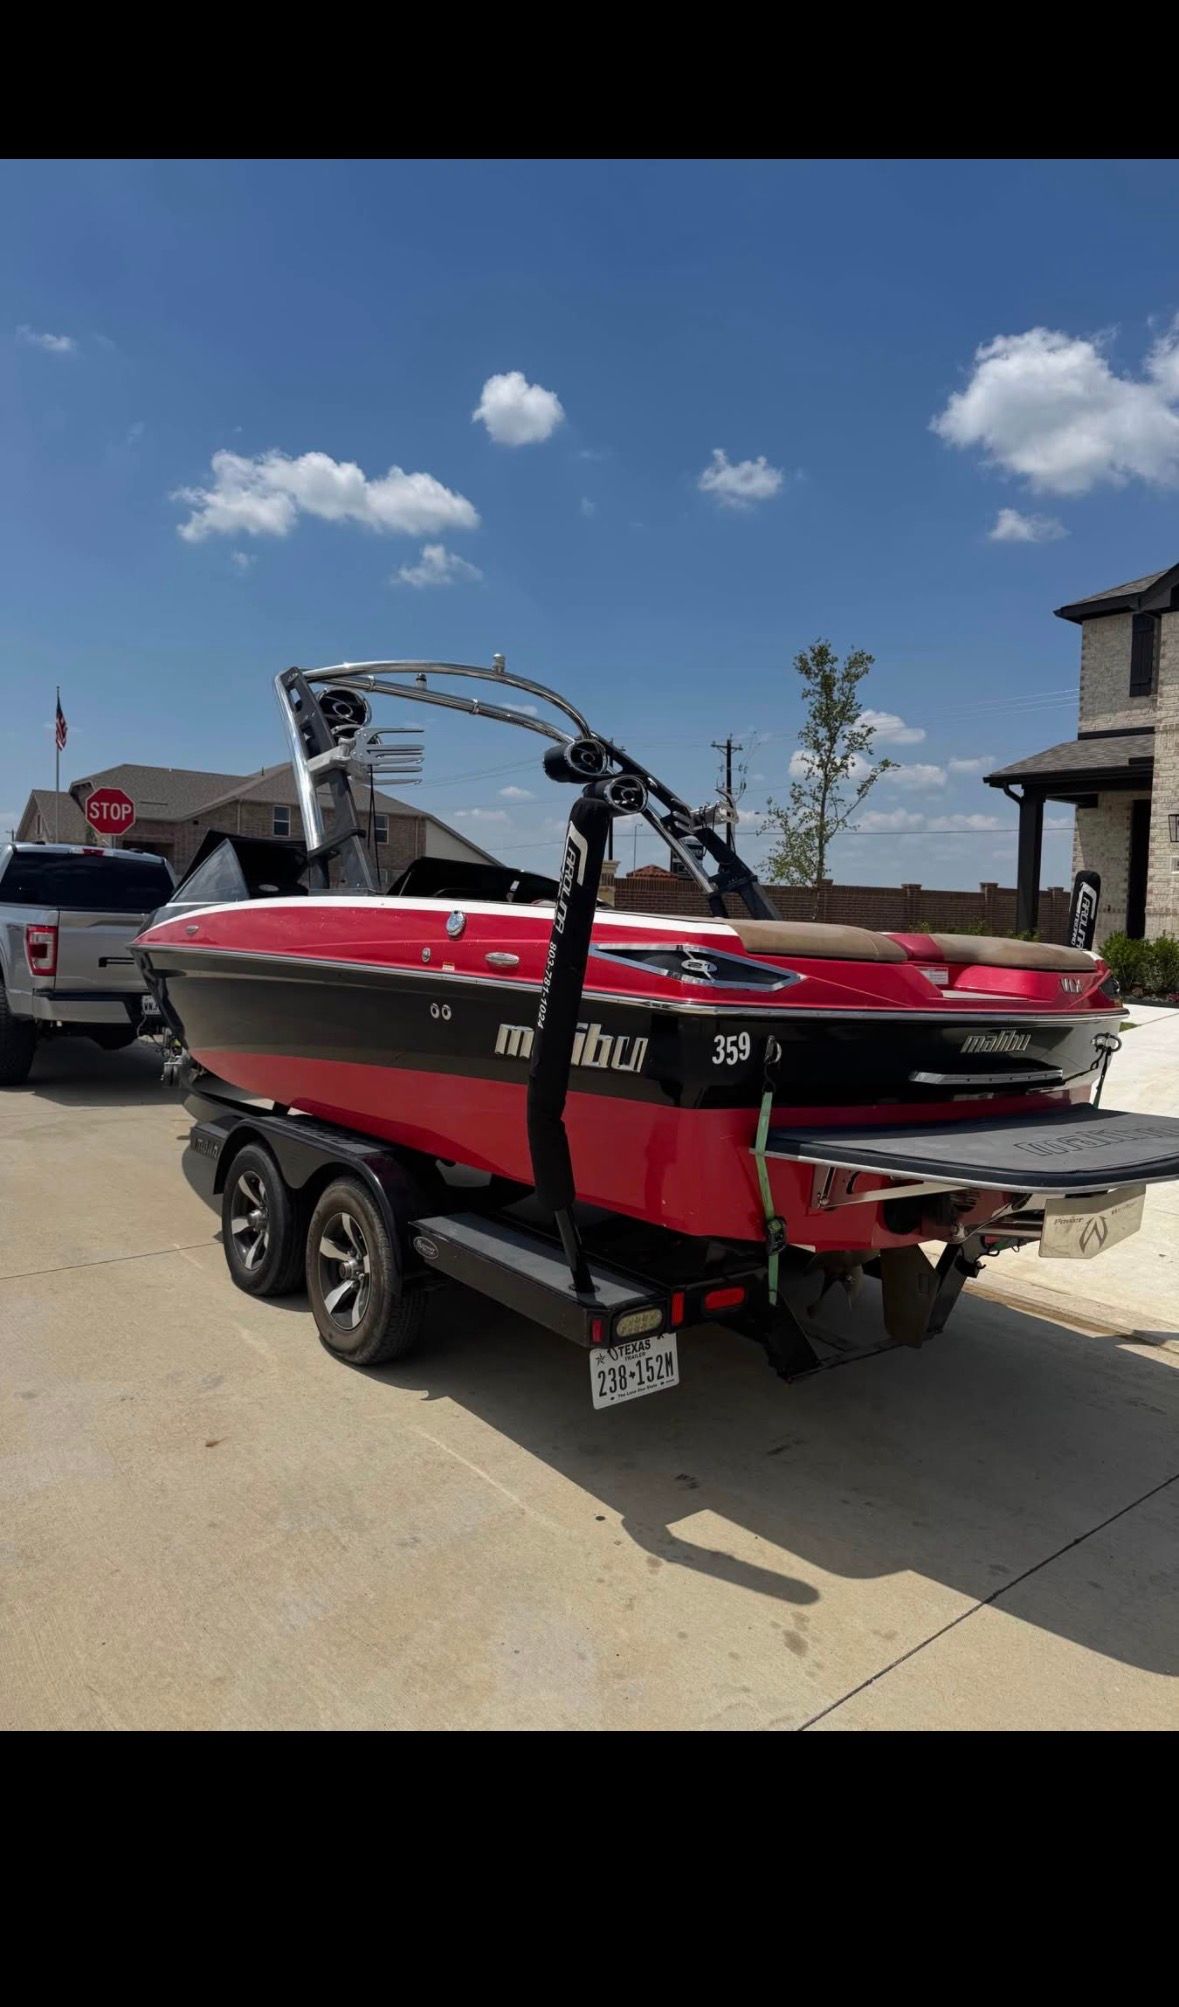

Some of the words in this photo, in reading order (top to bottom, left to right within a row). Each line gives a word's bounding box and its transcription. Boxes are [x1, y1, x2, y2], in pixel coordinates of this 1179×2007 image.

[89, 801, 132, 821] STOP
[537, 941, 557, 1029] 803-781-1024
[494, 1022, 649, 1073] mibu
[712, 1031, 751, 1065] 359
[618, 1340, 651, 1356] TEXAS
